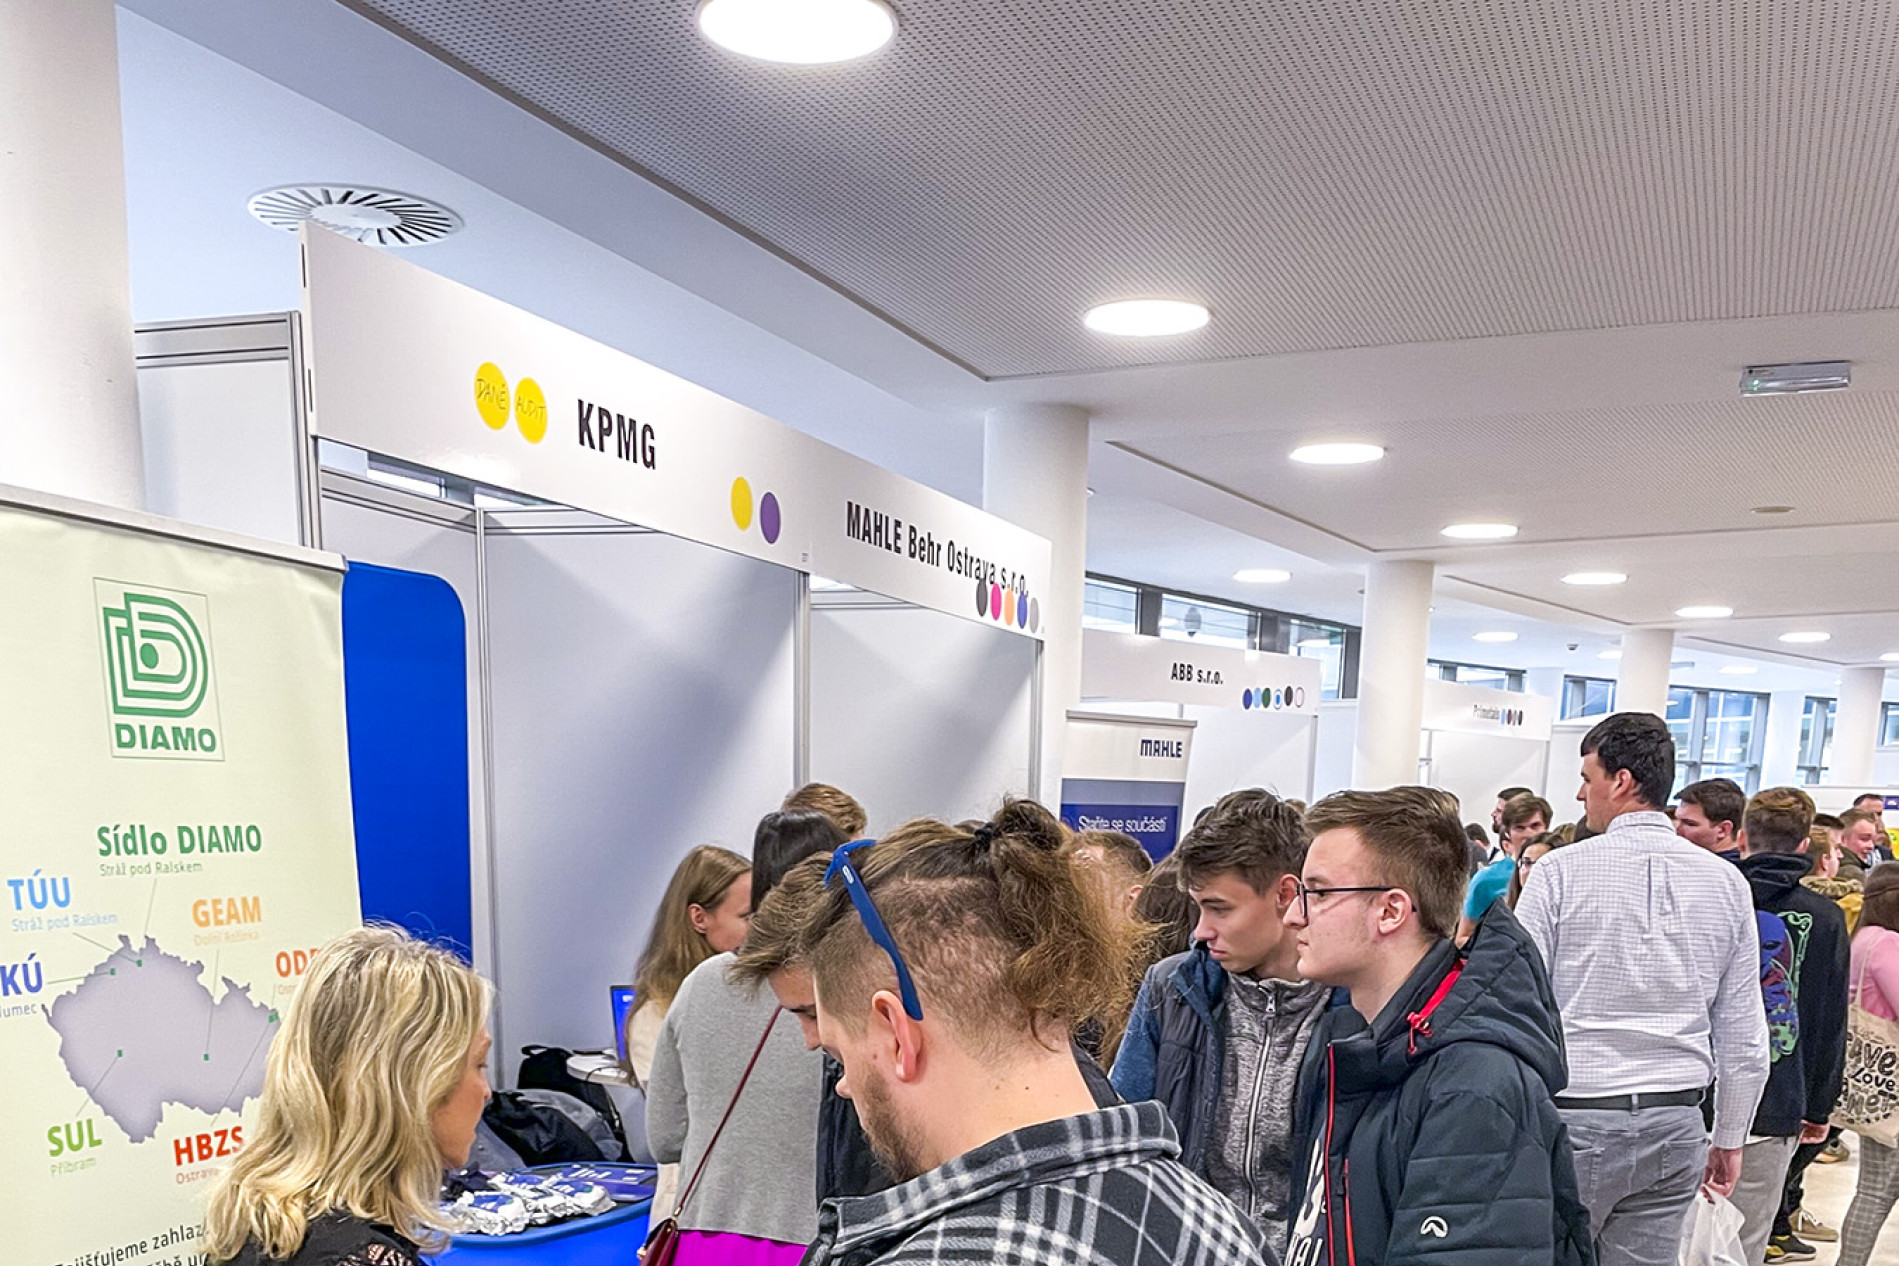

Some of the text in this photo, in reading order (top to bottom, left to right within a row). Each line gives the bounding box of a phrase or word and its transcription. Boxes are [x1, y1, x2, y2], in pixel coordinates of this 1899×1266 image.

[577, 398, 656, 470] KPMG
[846, 500, 902, 554] MAHLE
[908, 525, 942, 567] Behr
[947, 540, 996, 585] Ostrava
[1170, 662, 1224, 685] ABB s.r.o.
[115, 722, 217, 753] DIAMO
[1140, 739, 1183, 758] MAHLE
[97, 824, 262, 857] Sídlo DIAMO
[1111, 820, 1125, 833] se
[99, 861, 203, 878] Stráž pod Ralskem
[7, 869, 71, 911] TÚU
[47, 915, 70, 930] pod
[192, 896, 262, 928] GEAM
[0, 952, 43, 996] KÚ
[47, 1118, 102, 1157] SUL
[173, 1125, 244, 1166] HBZS
